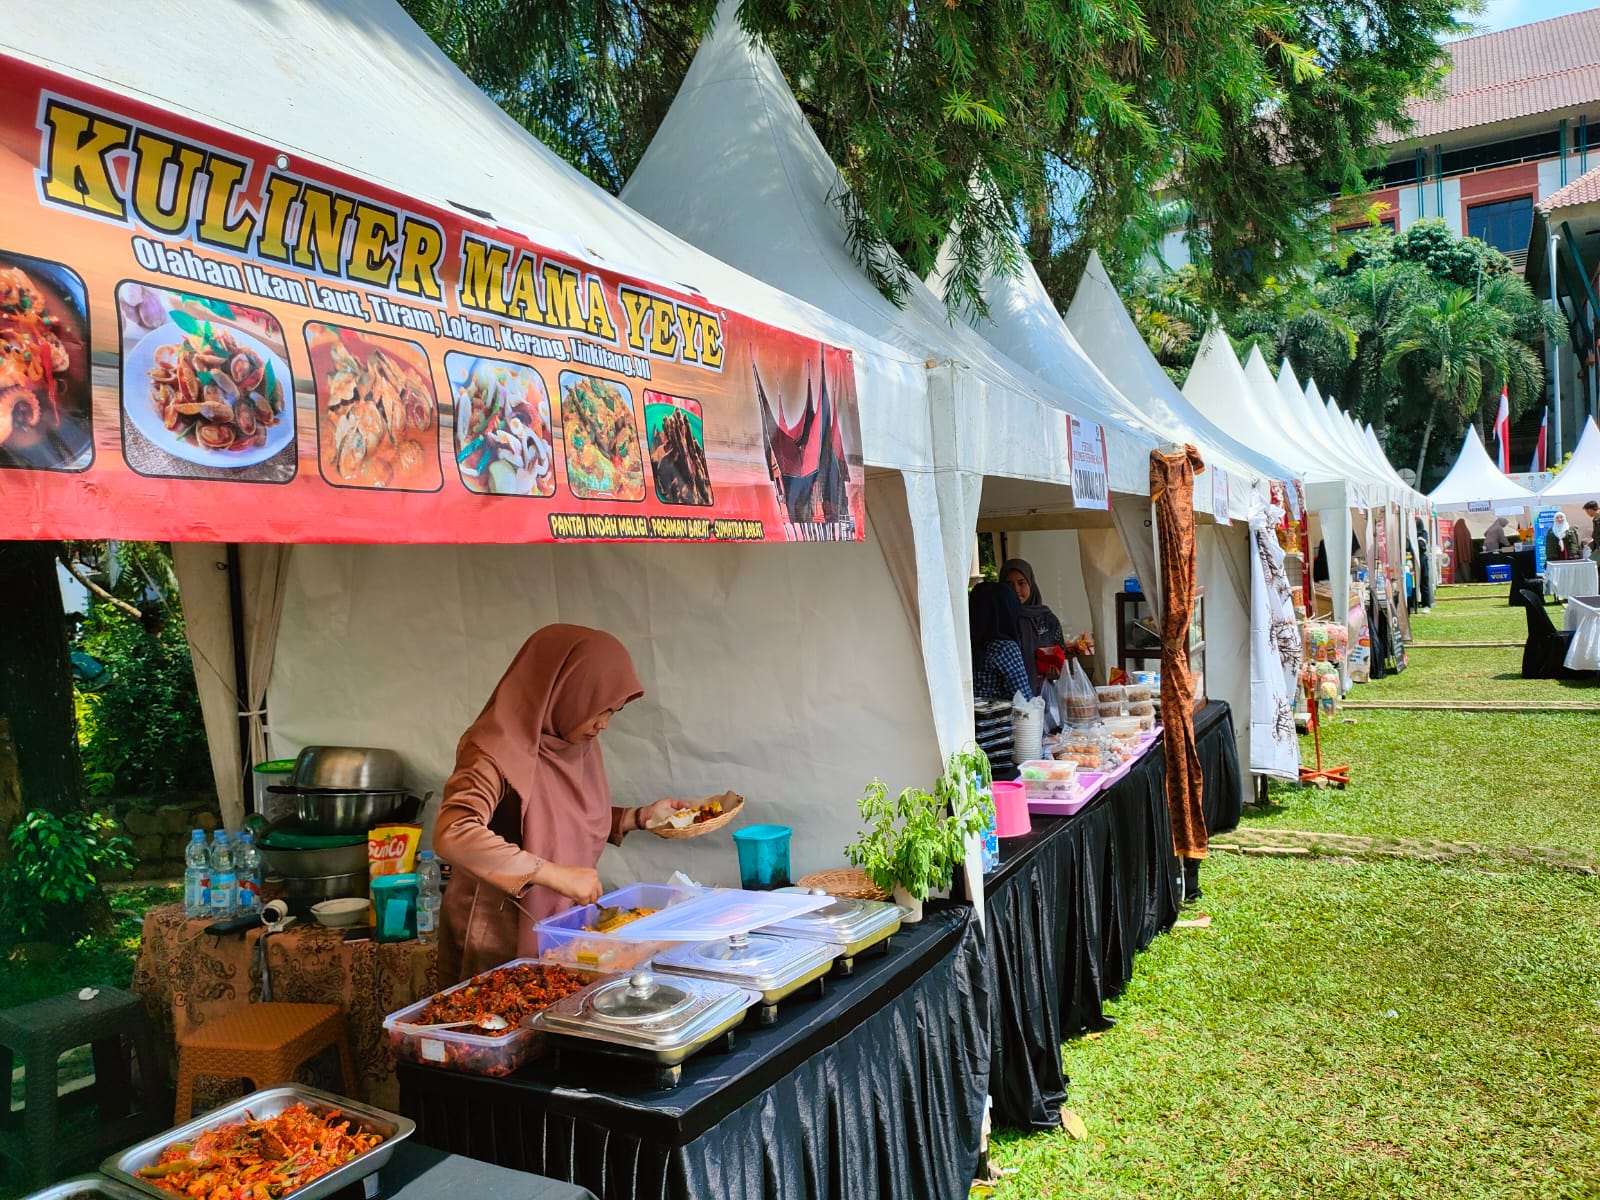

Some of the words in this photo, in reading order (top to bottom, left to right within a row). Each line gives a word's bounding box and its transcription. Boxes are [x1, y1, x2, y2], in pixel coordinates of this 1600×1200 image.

[42, 98, 444, 301] KULINER
[459, 235, 617, 343] MAMA
[620, 287, 723, 370] YEYE
[132, 235, 244, 294] Olahan
[247, 263, 307, 309] Ikan
[309, 278, 370, 323] Laut,
[369, 295, 441, 338] Tiram,
[440, 311, 501, 351] Lokan,
[500, 325, 570, 362] Kerang,
[550, 515, 586, 537] PANTAI
[587, 515, 618, 537] INDAH
[618, 516, 649, 537] MALIGI
[651, 518, 688, 538] PASAMAN
[687, 519, 710, 538] BARAT
[714, 519, 744, 539] SUMATRA
[368, 837, 405, 858] SunCo
